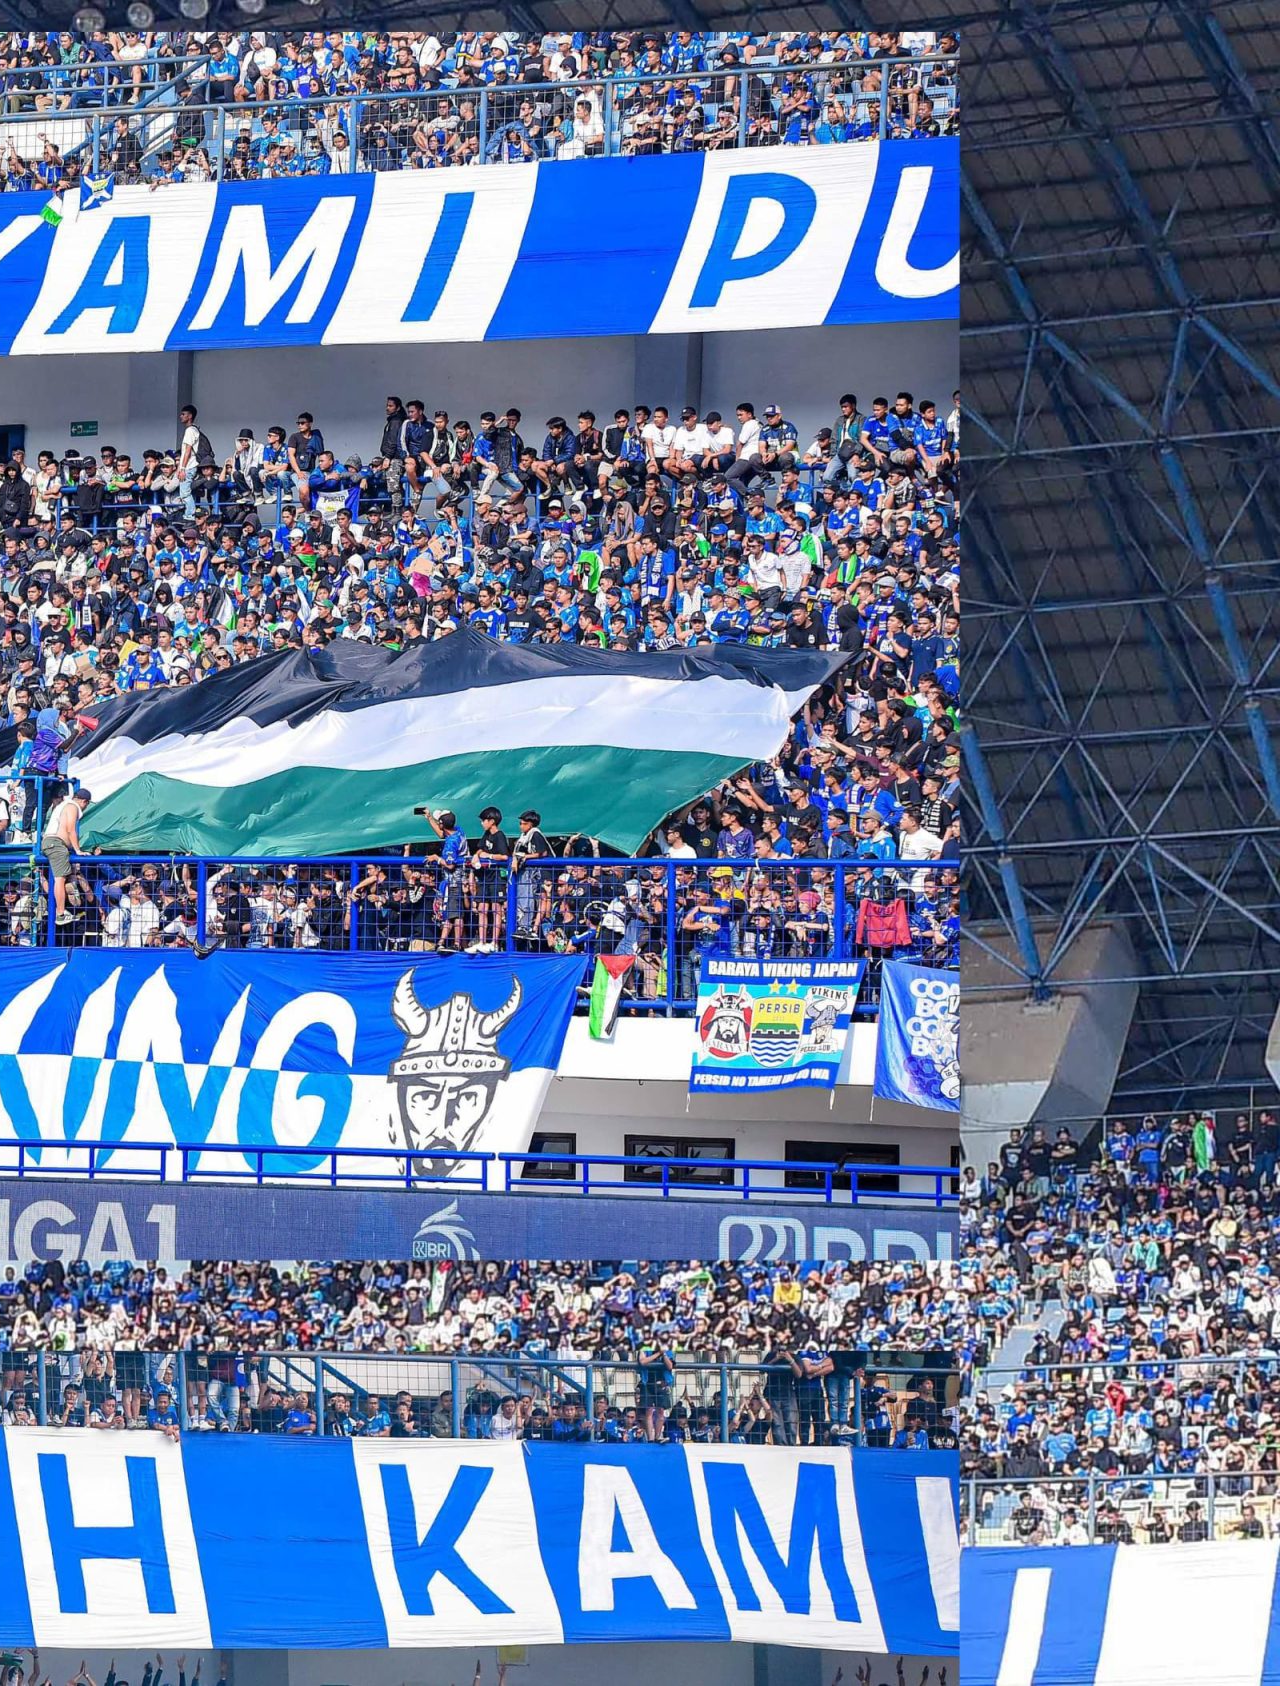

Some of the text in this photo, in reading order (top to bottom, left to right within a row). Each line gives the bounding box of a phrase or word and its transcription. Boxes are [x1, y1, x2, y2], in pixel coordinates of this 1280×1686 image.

[689, 166, 960, 308] PU
[708, 961, 858, 978] BARAYA VIKING JAPAN
[811, 988, 849, 1000] VIKING
[758, 1003, 801, 1013] PERSIB
[427, 1242, 451, 1258] BRI
